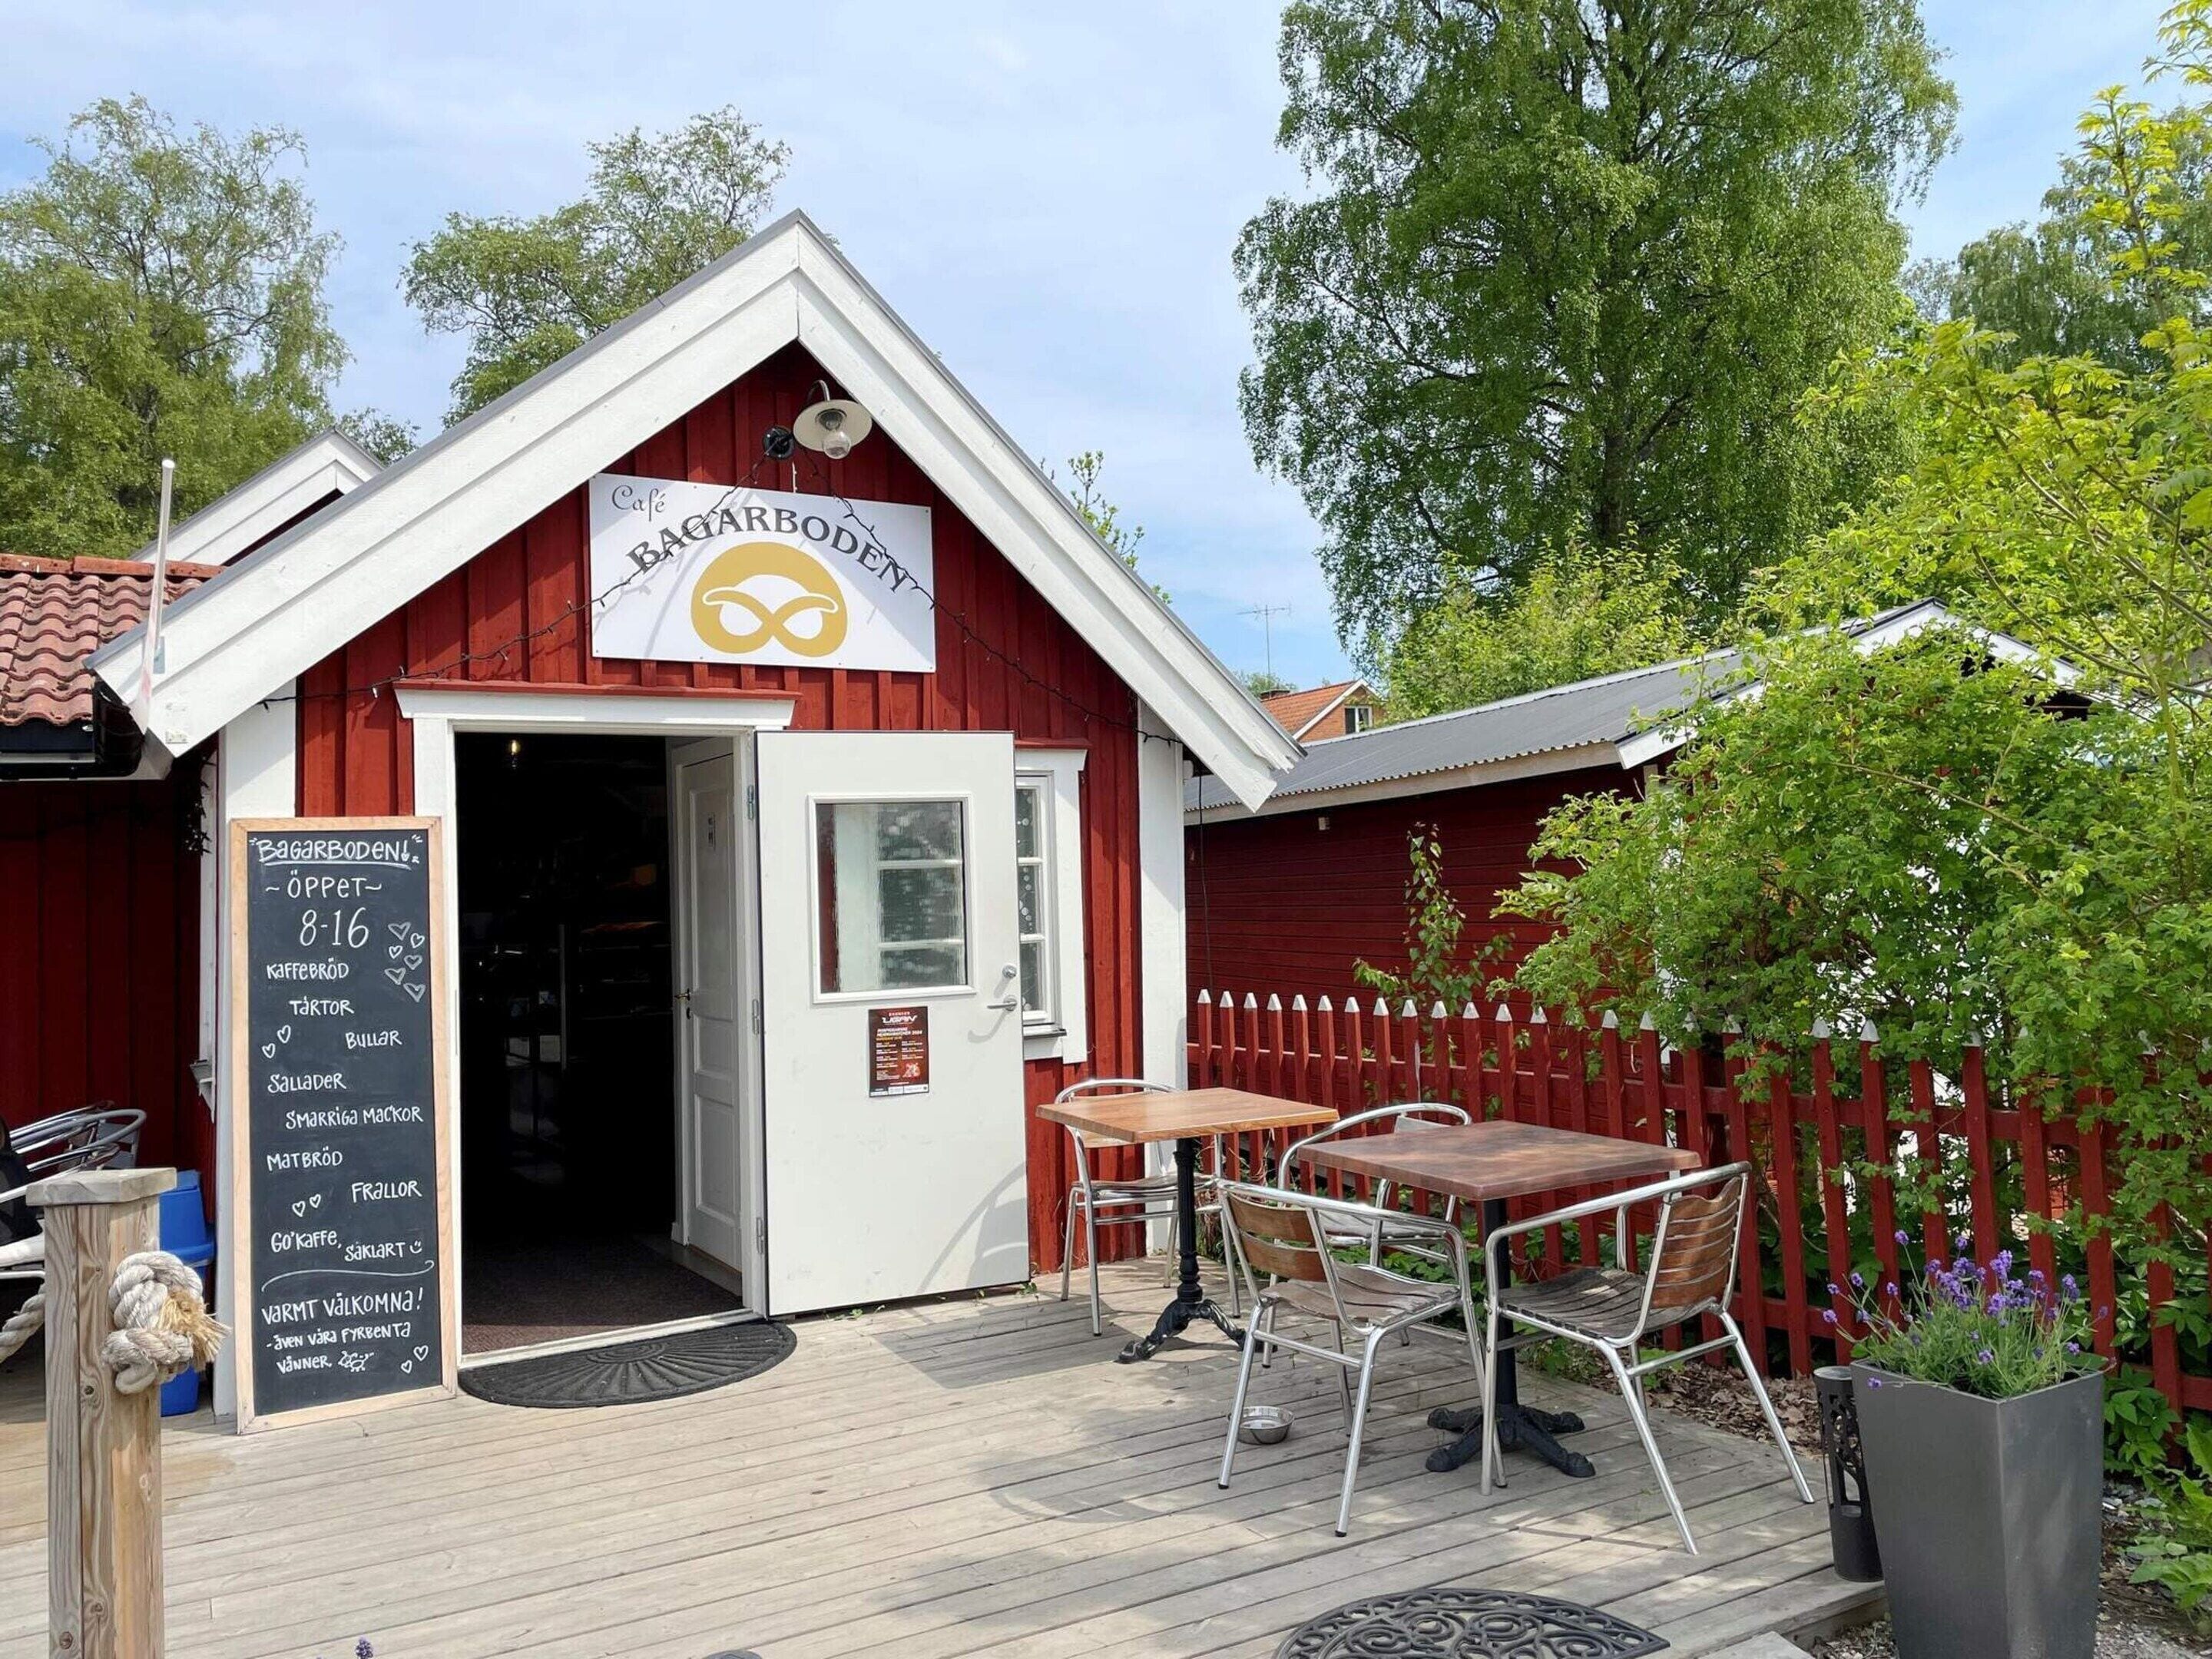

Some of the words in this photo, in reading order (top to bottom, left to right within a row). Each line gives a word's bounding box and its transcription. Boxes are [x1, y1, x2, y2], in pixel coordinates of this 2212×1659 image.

[611, 485, 666, 522] Café
[625, 506, 908, 593] BAGARBODEN
[300, 906, 369, 949] 8-16
